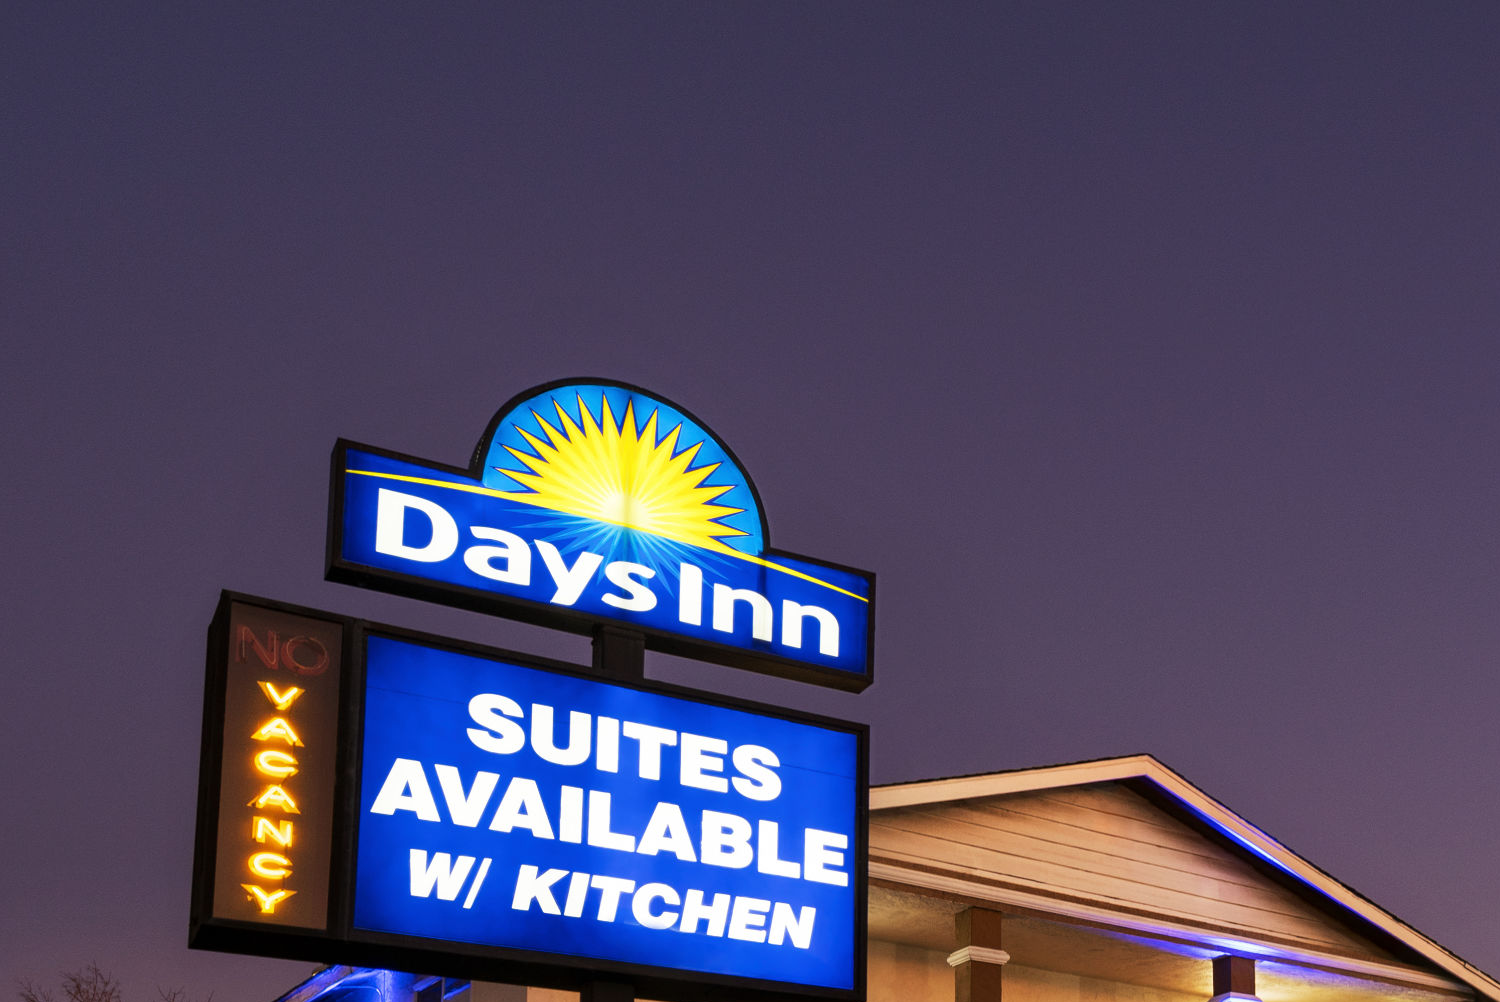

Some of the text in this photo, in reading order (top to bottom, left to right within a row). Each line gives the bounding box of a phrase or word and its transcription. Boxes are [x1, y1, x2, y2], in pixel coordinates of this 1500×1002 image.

[375, 487, 840, 658] Days Inn
[234, 623, 330, 677] NO
[240, 680, 306, 914] VACANCY
[466, 692, 782, 802] SUITES
[370, 757, 849, 887] AVAILABLE
[409, 848, 817, 950] W/ KITCHEN
